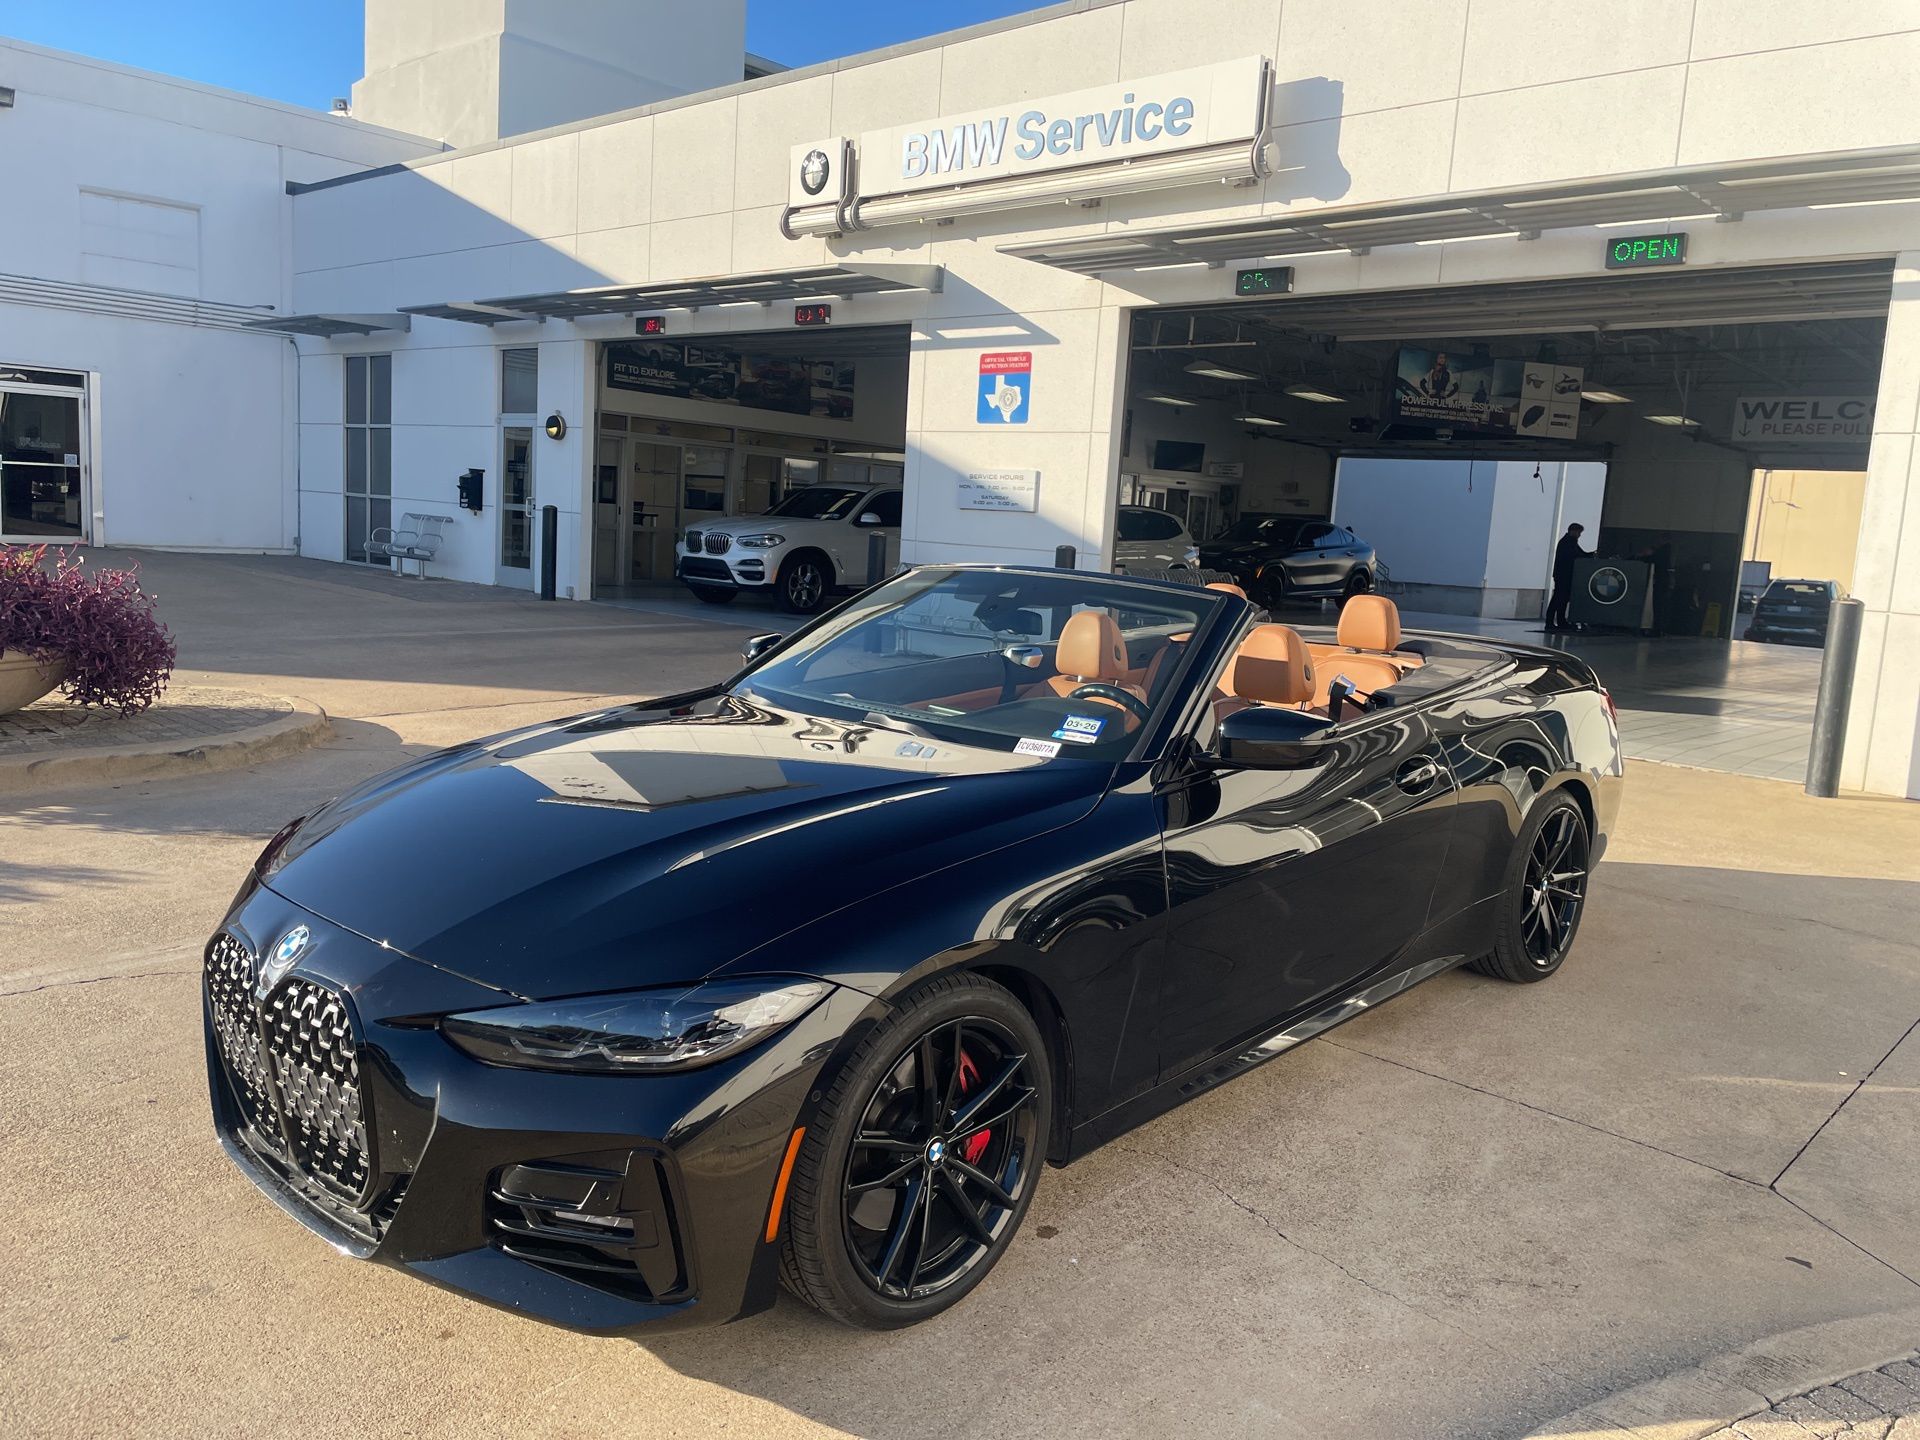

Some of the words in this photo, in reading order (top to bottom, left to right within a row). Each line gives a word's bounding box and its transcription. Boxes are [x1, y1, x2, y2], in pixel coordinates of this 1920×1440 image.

[902, 117, 1009, 179] BMW
[1014, 92, 1194, 160] Service
[1613, 237, 1678, 262] OPEN
[614, 362, 627, 372] FIT
[628, 365, 639, 374] TO
[640, 368, 676, 379] EXPLORE
[1401, 395, 1447, 408] POWERFUL
[1741, 400, 1876, 420] WELC
[1761, 423, 1826, 436] PLEASE
